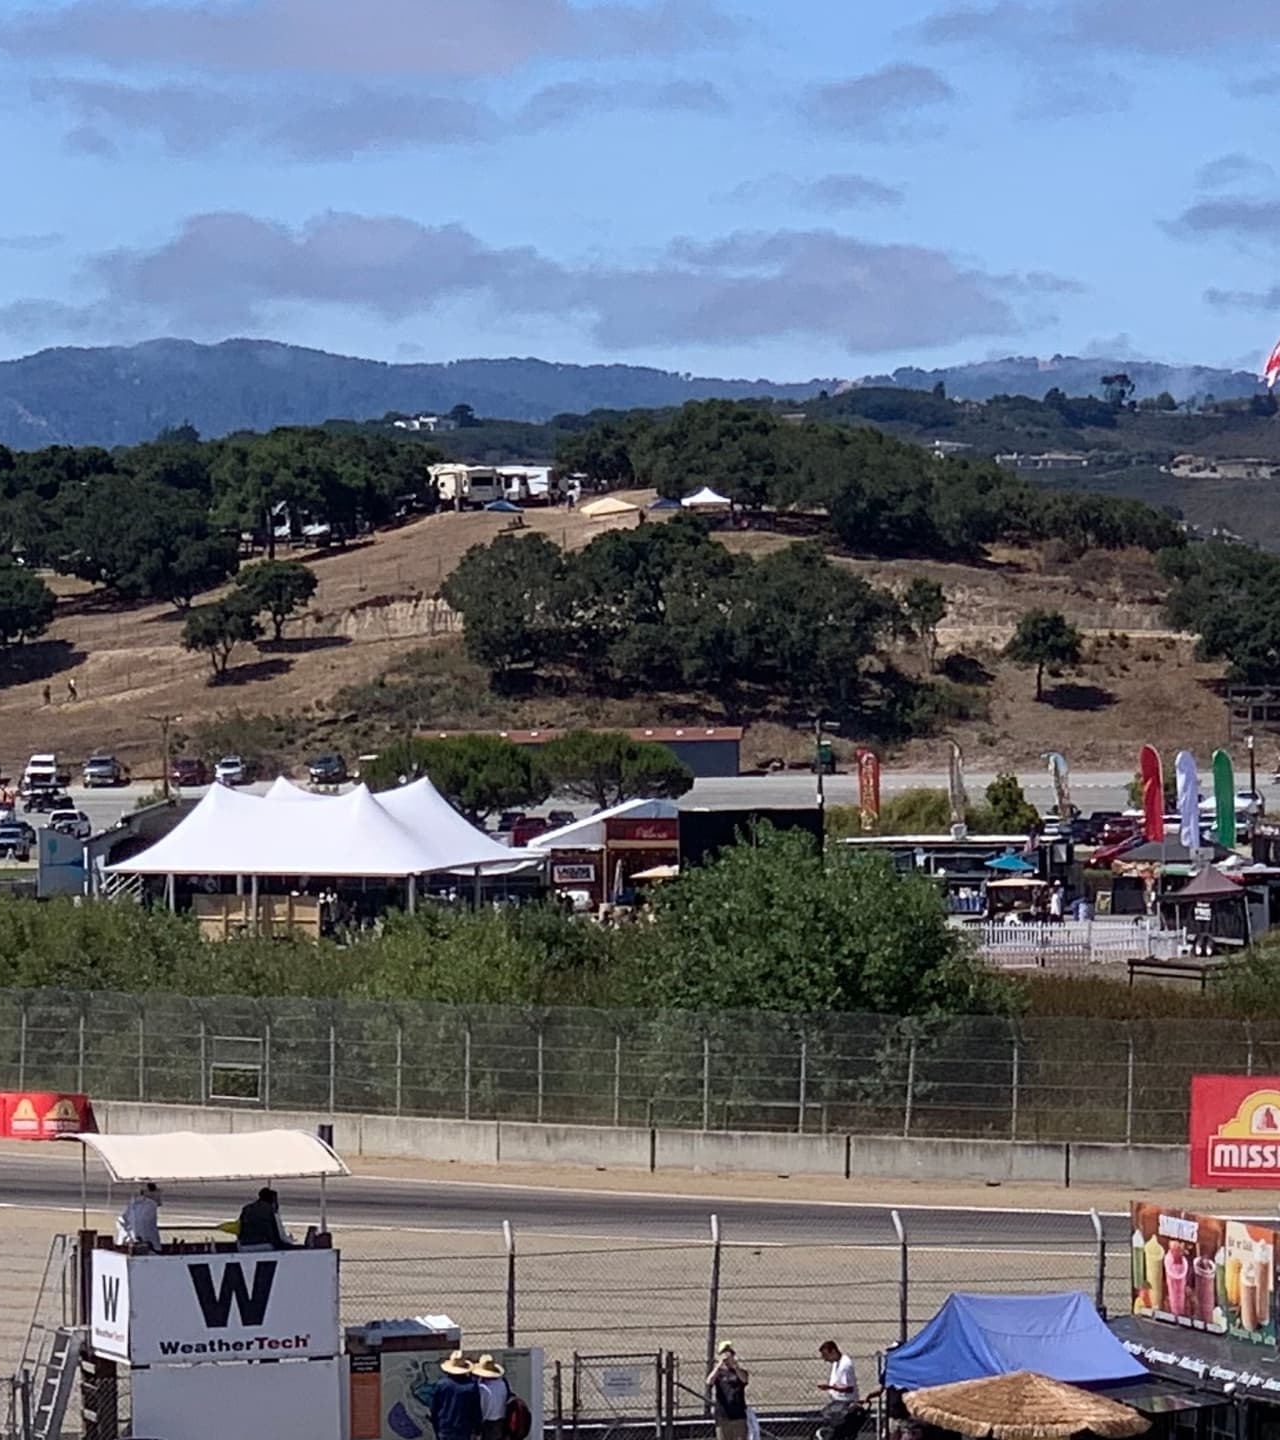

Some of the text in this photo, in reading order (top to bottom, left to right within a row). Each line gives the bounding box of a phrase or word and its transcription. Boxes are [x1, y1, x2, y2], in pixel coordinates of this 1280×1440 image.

[101, 1274, 120, 1323] W
[187, 1260, 278, 1328] W
[159, 1335, 308, 1355] WeatherTech
